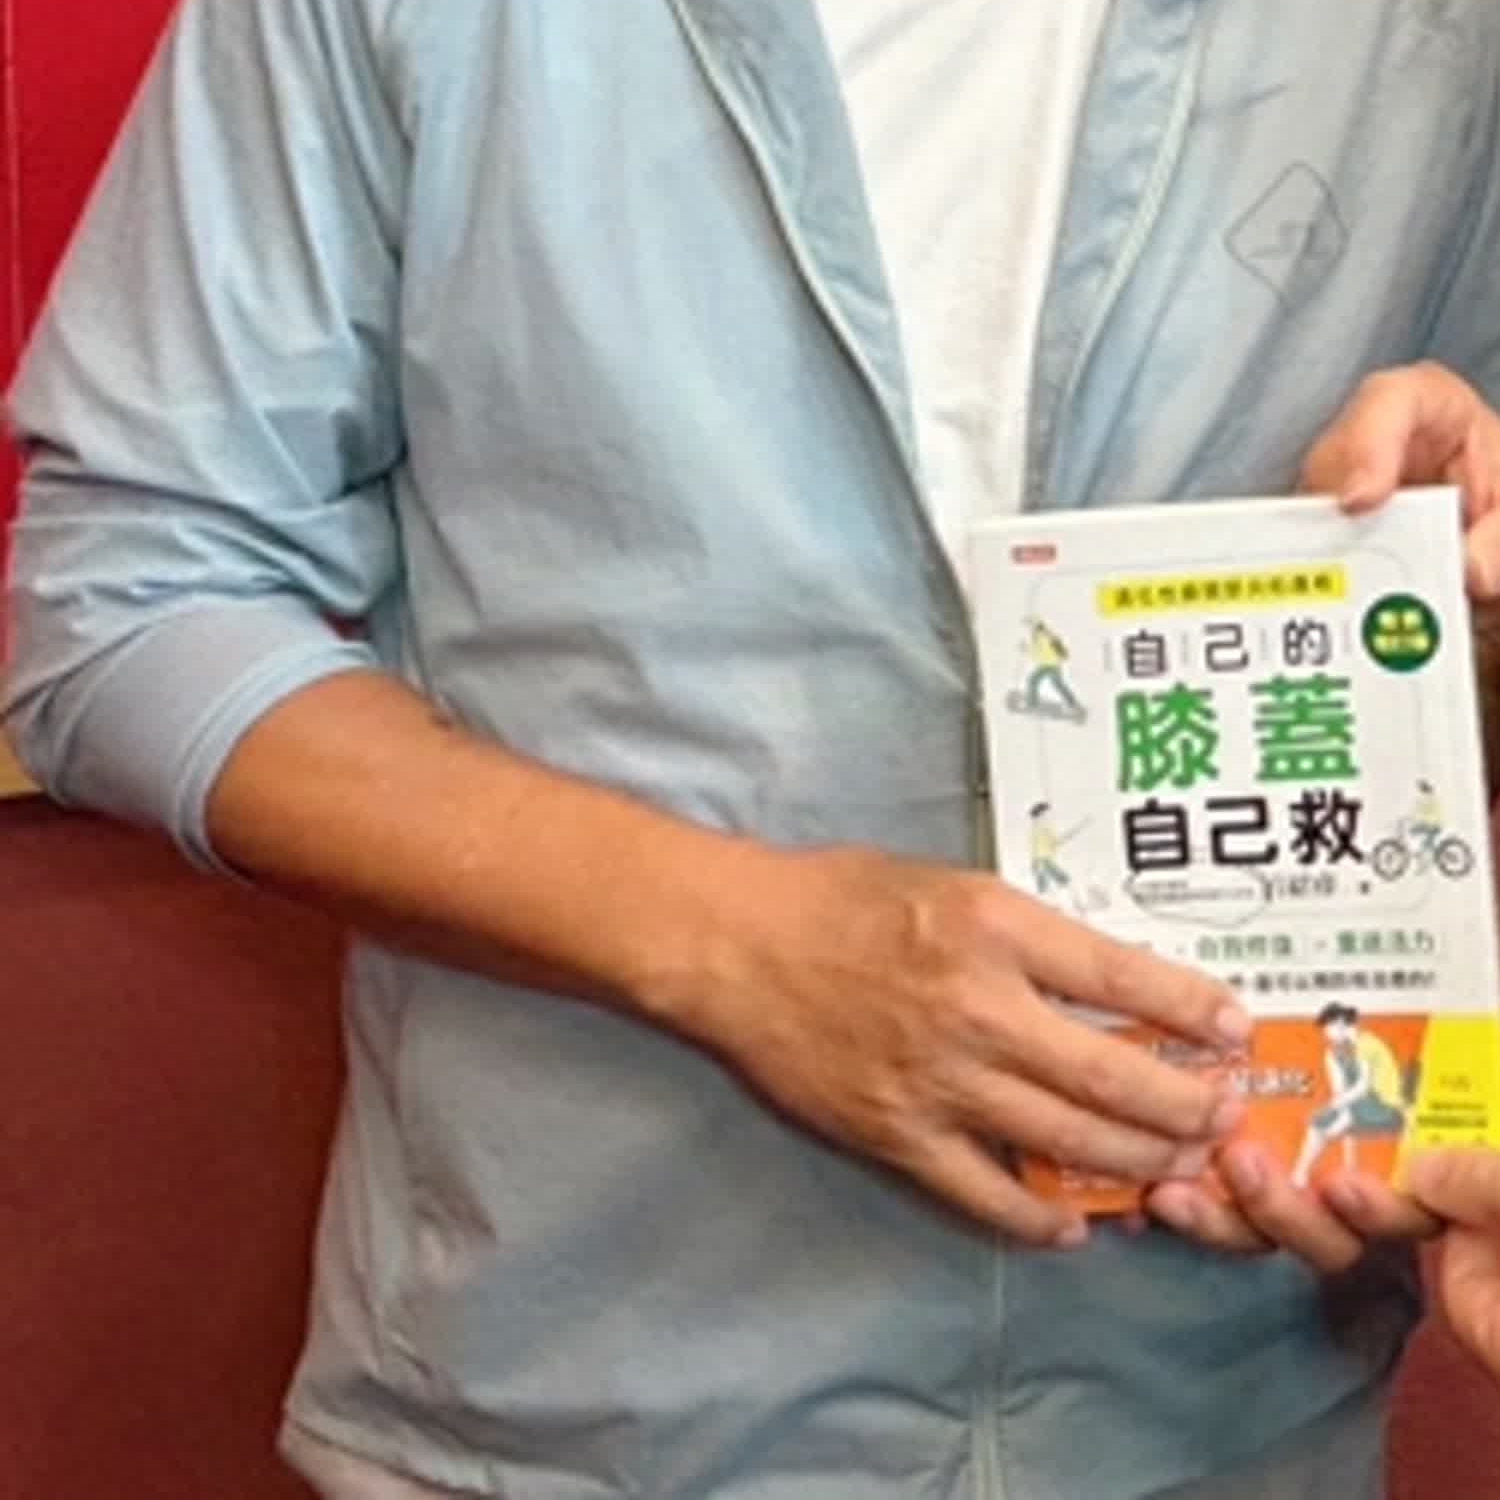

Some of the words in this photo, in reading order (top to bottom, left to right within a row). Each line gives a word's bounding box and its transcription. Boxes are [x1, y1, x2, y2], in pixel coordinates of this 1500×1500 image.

[1122, 617, 1332, 678] 自己的
[1114, 672, 1360, 794] 膝蓋
[1122, 787, 1364, 871] 自己救
